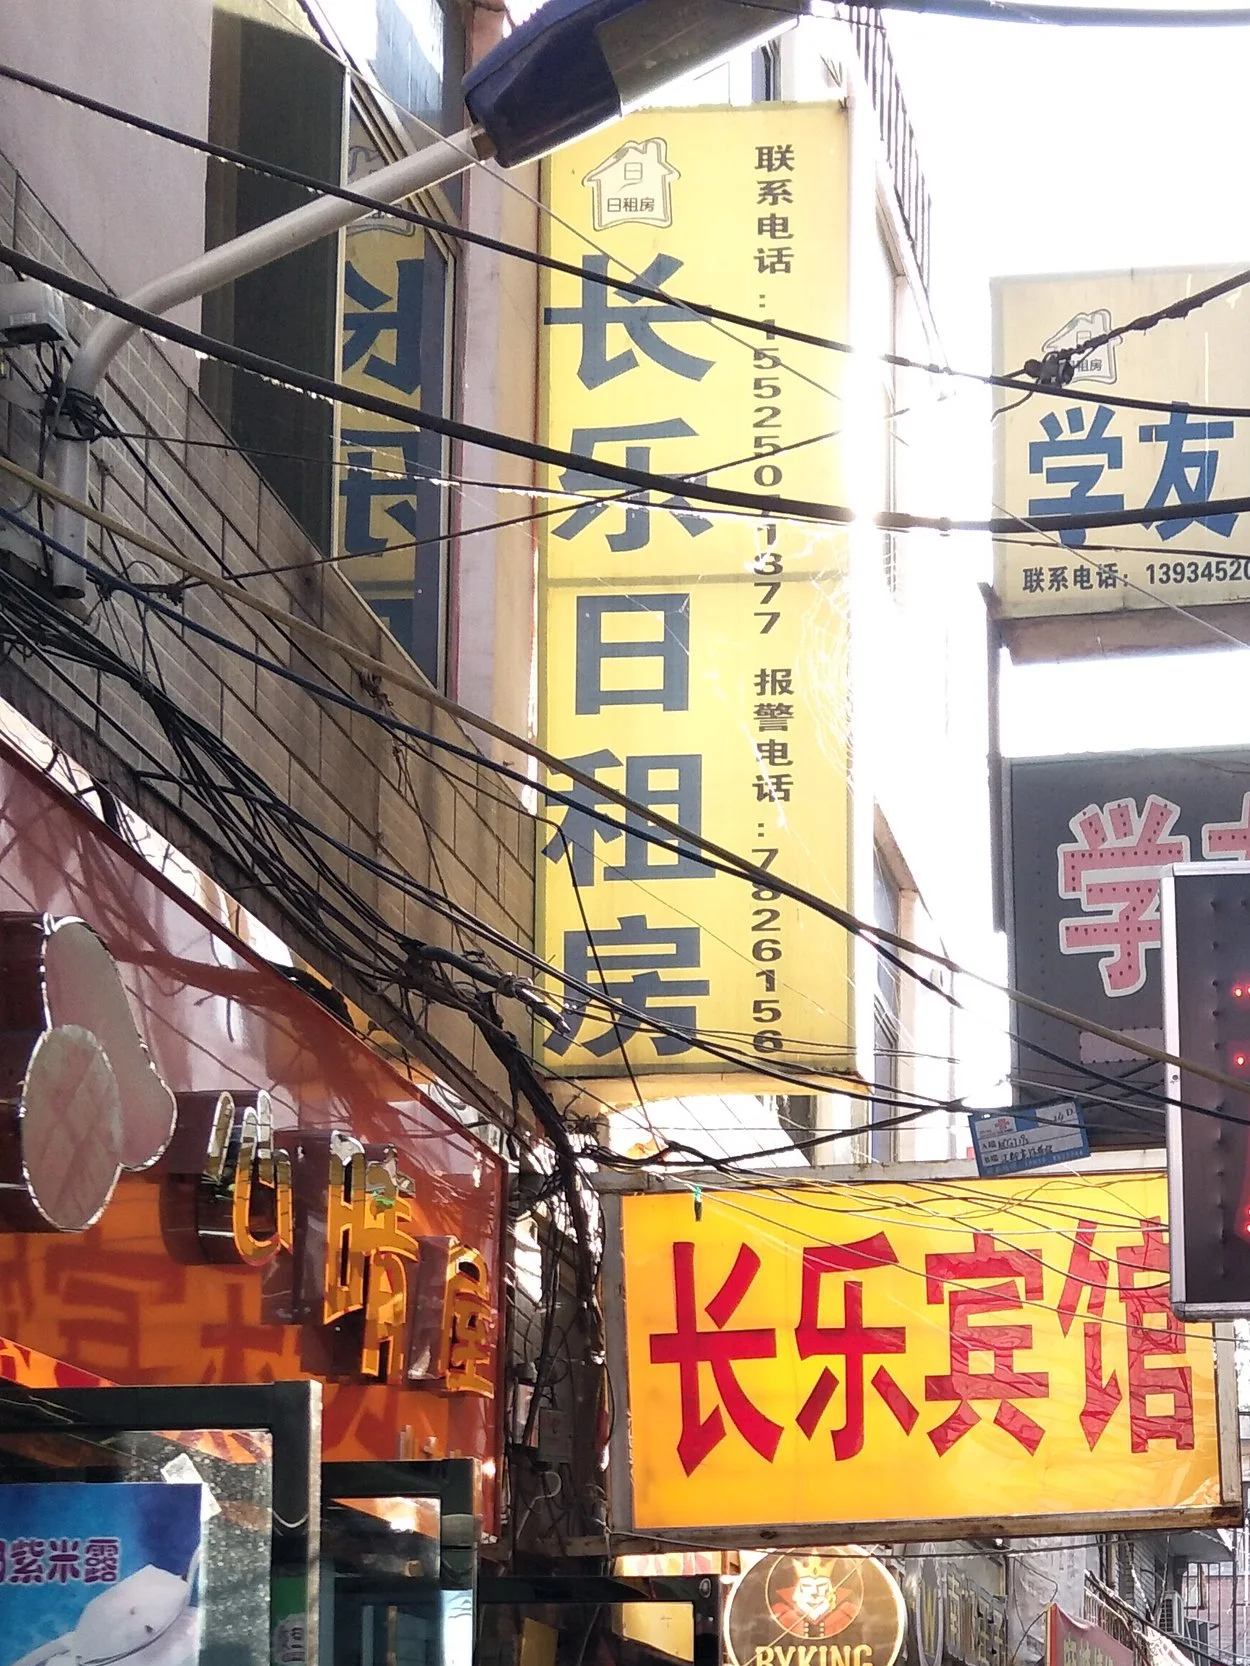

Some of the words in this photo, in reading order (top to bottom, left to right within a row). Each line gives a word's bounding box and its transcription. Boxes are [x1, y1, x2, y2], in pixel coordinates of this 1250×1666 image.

[606, 196, 656, 213] 日租房
[541, 253, 716, 1058] 长乐日租房
[648, 1216, 1194, 1478] 长乐宾馆
[0, 1538, 119, 1584] 紫米露
